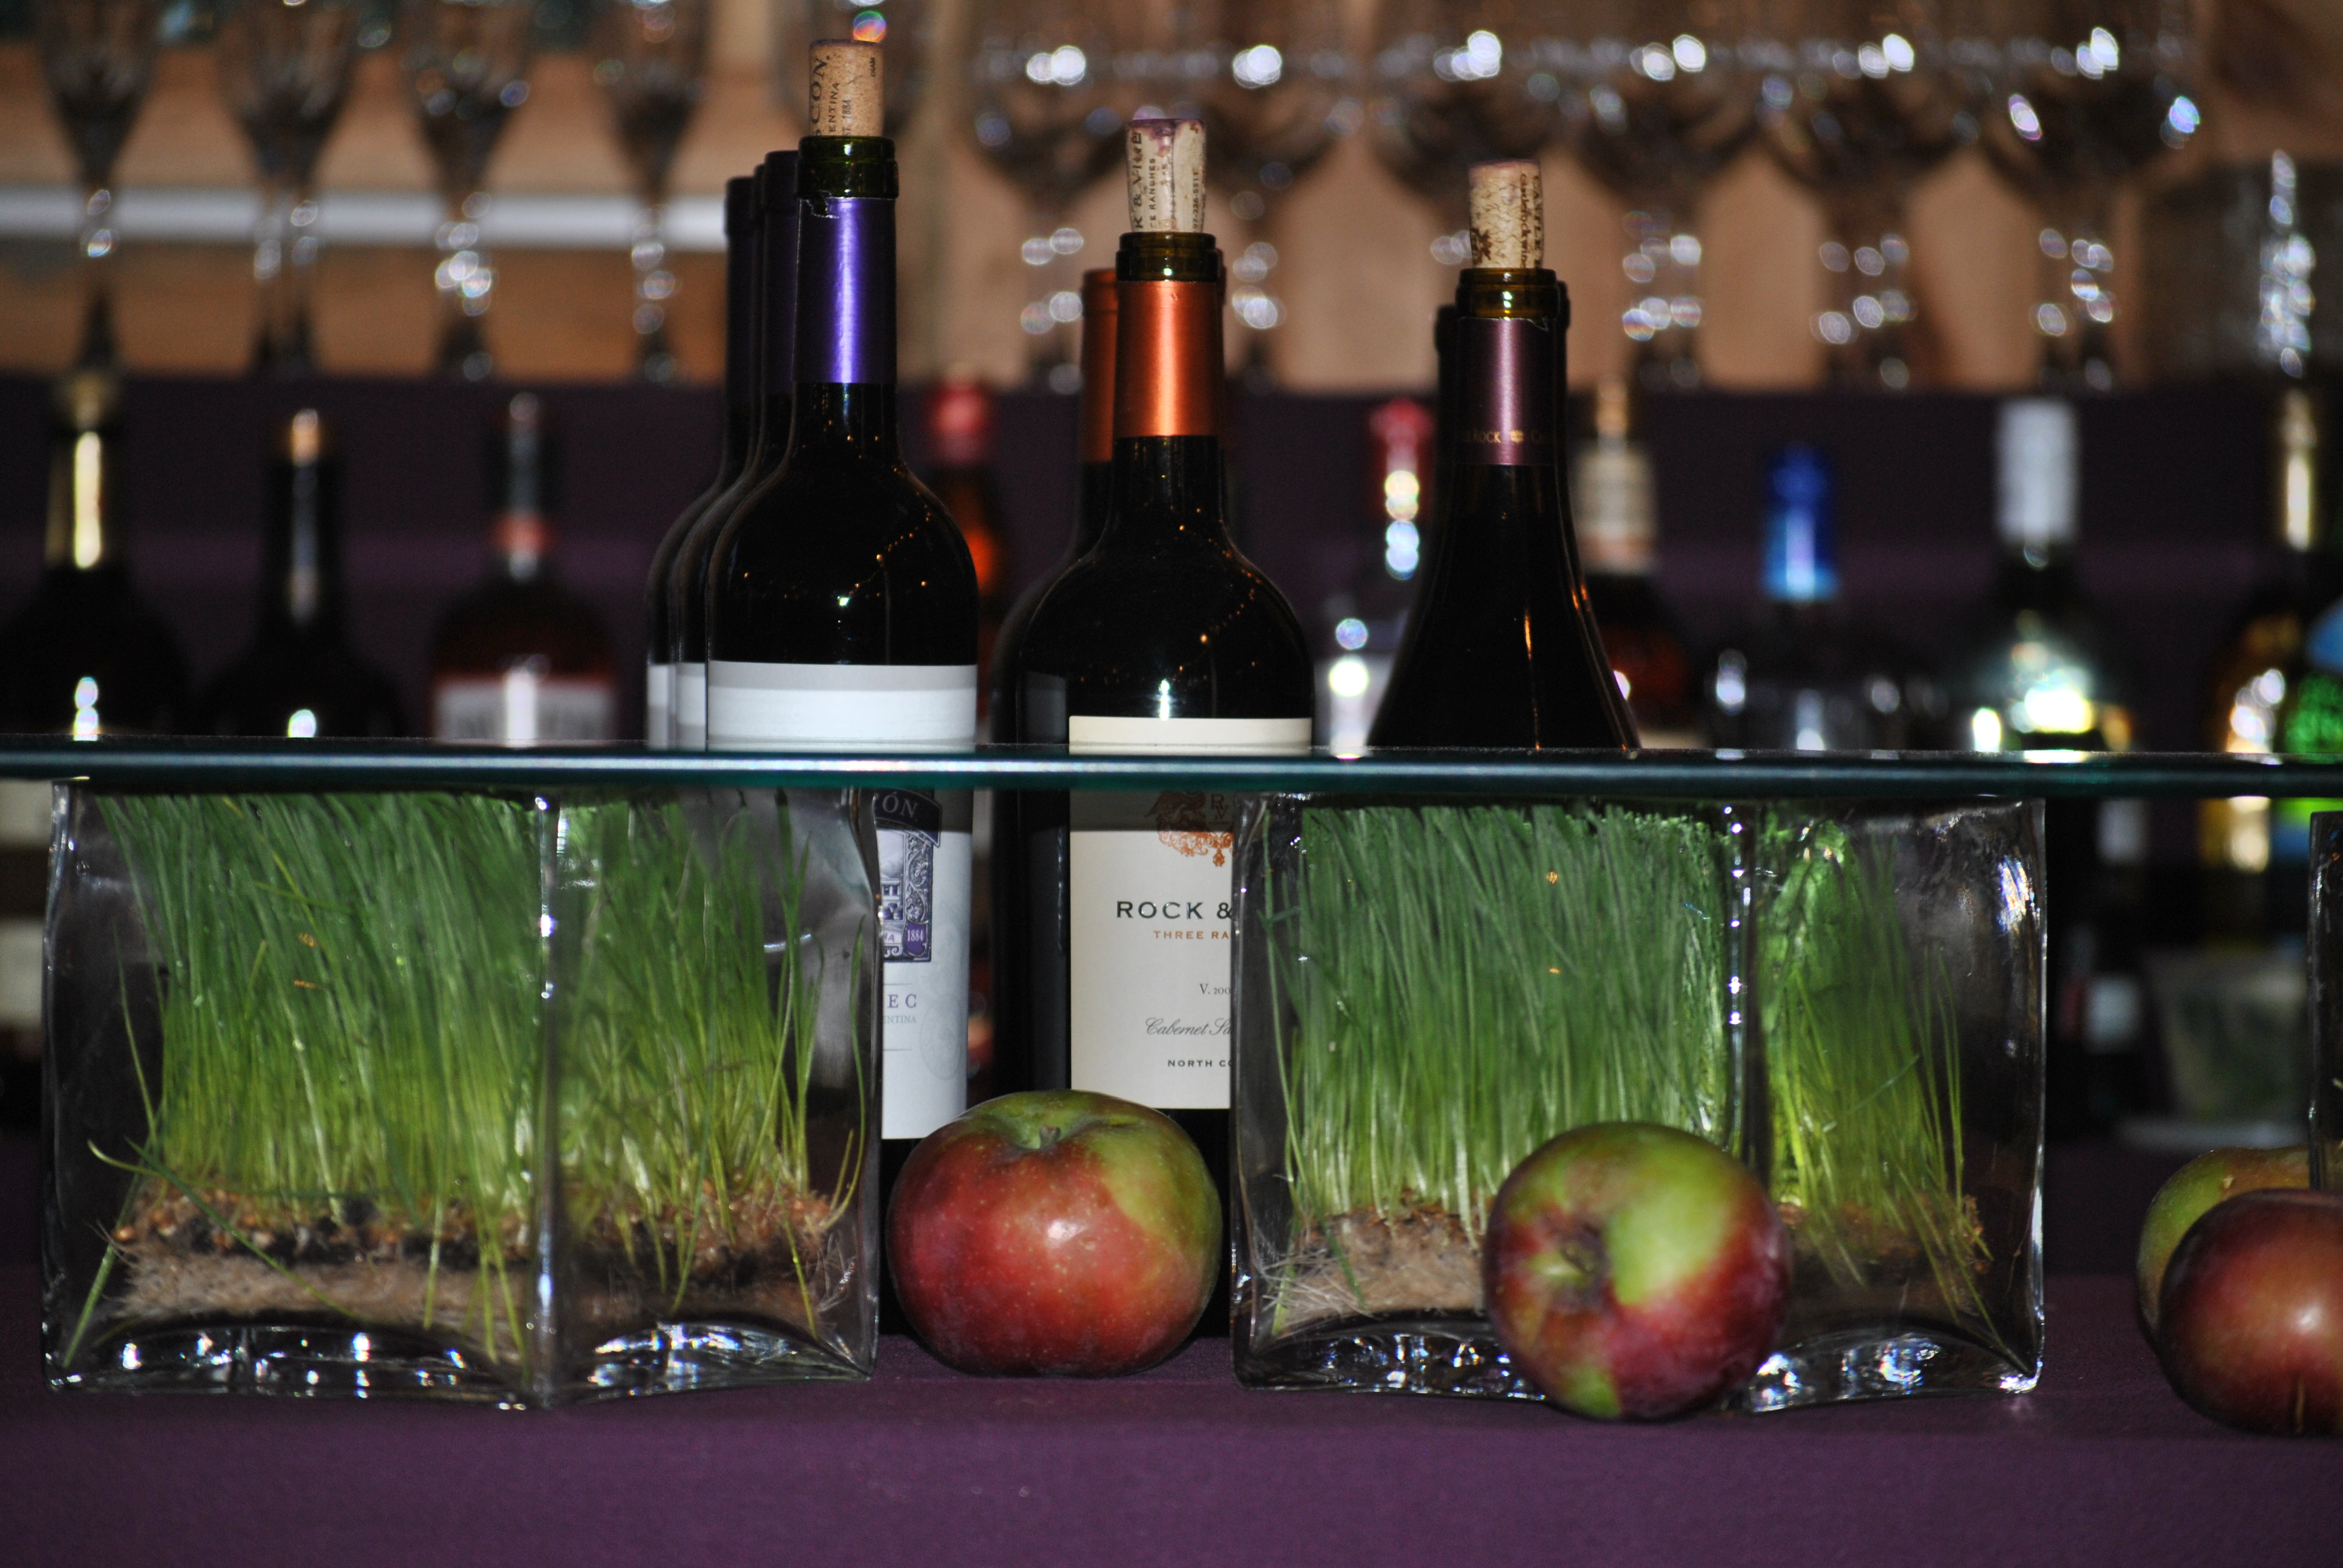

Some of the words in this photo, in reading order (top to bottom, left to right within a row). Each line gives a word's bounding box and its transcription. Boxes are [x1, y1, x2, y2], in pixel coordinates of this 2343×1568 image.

[828, 82, 840, 132] ENTINA
[1133, 194, 1142, 207] &
[1116, 901, 1203, 919] ROCK
[1216, 902, 1232, 919] &
[907, 929, 923, 941] 1884
[1153, 930, 1204, 939] THREE
[1211, 931, 1230, 939] RA
[1199, 983, 1210, 995] V.
[1145, 1018, 1209, 1036] Cabernet
